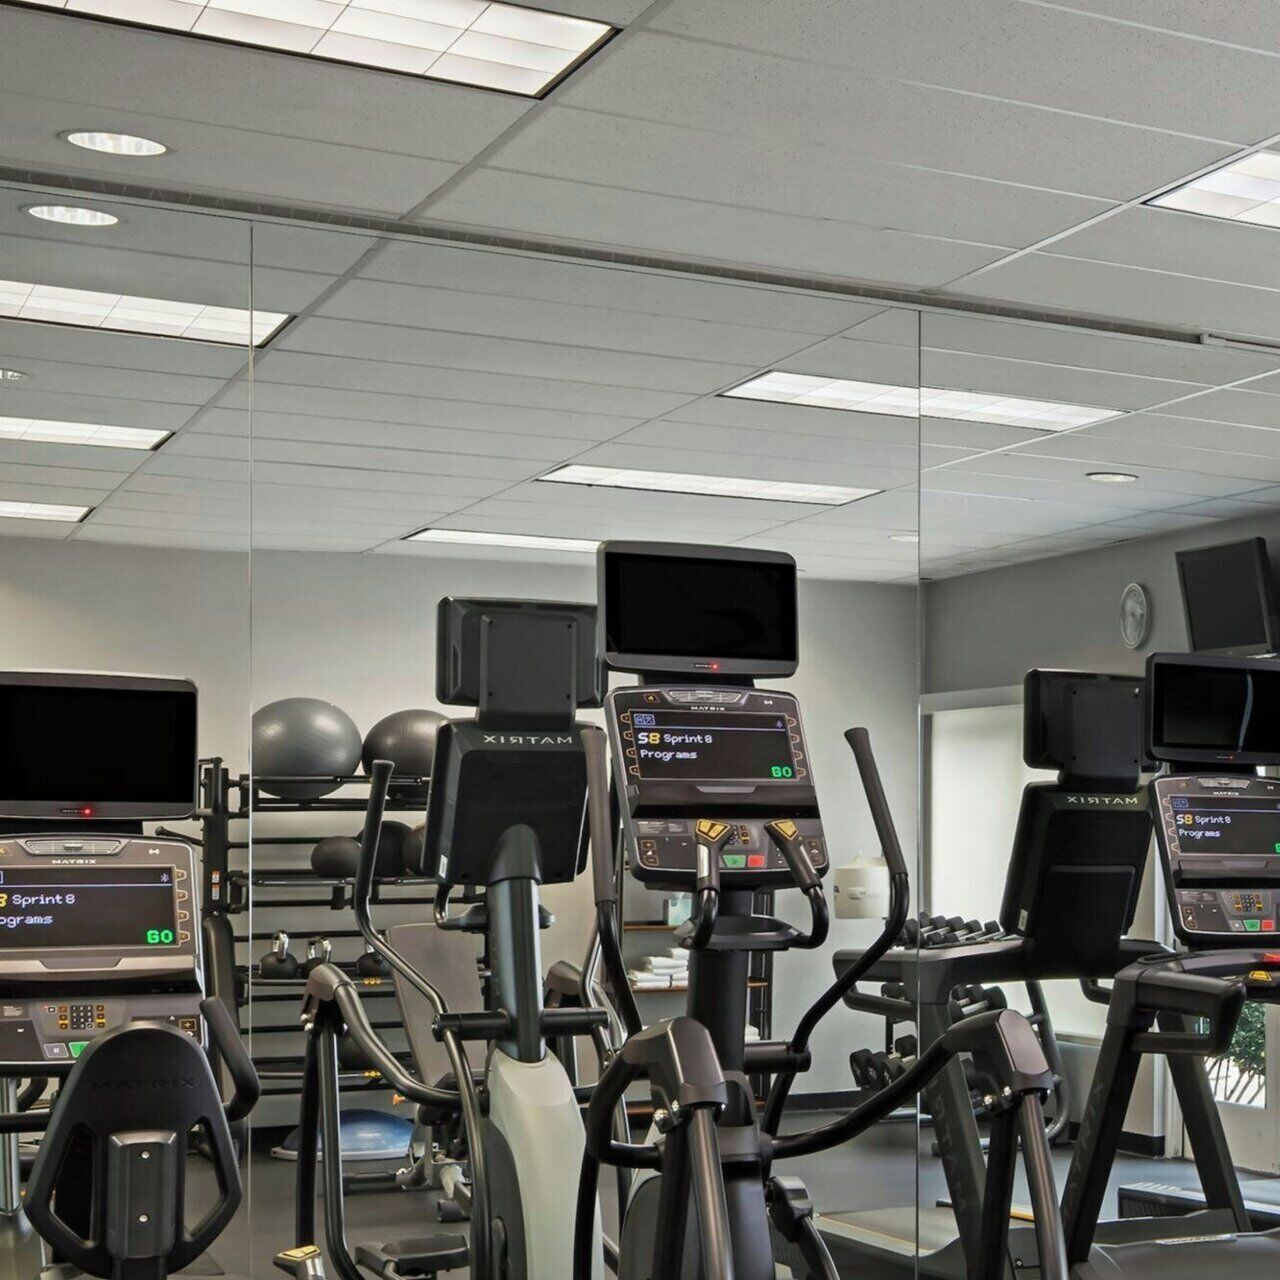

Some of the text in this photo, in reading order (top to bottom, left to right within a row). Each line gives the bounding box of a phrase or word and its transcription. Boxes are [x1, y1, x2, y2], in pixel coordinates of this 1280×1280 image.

[638, 733, 660, 744] S8
[664, 734, 703, 745] Sprint
[641, 749, 697, 761] Programs
[772, 766, 792, 778] GO
[1176, 814, 1193, 825] S8
[1195, 815, 1223, 825] Sprint
[1179, 829, 1220, 839] Programs
[12, 894, 62, 908] Sprint
[66, 894, 75, 904] 8
[0, 914, 53, 928] ograms
[147, 930, 173, 943] GO
